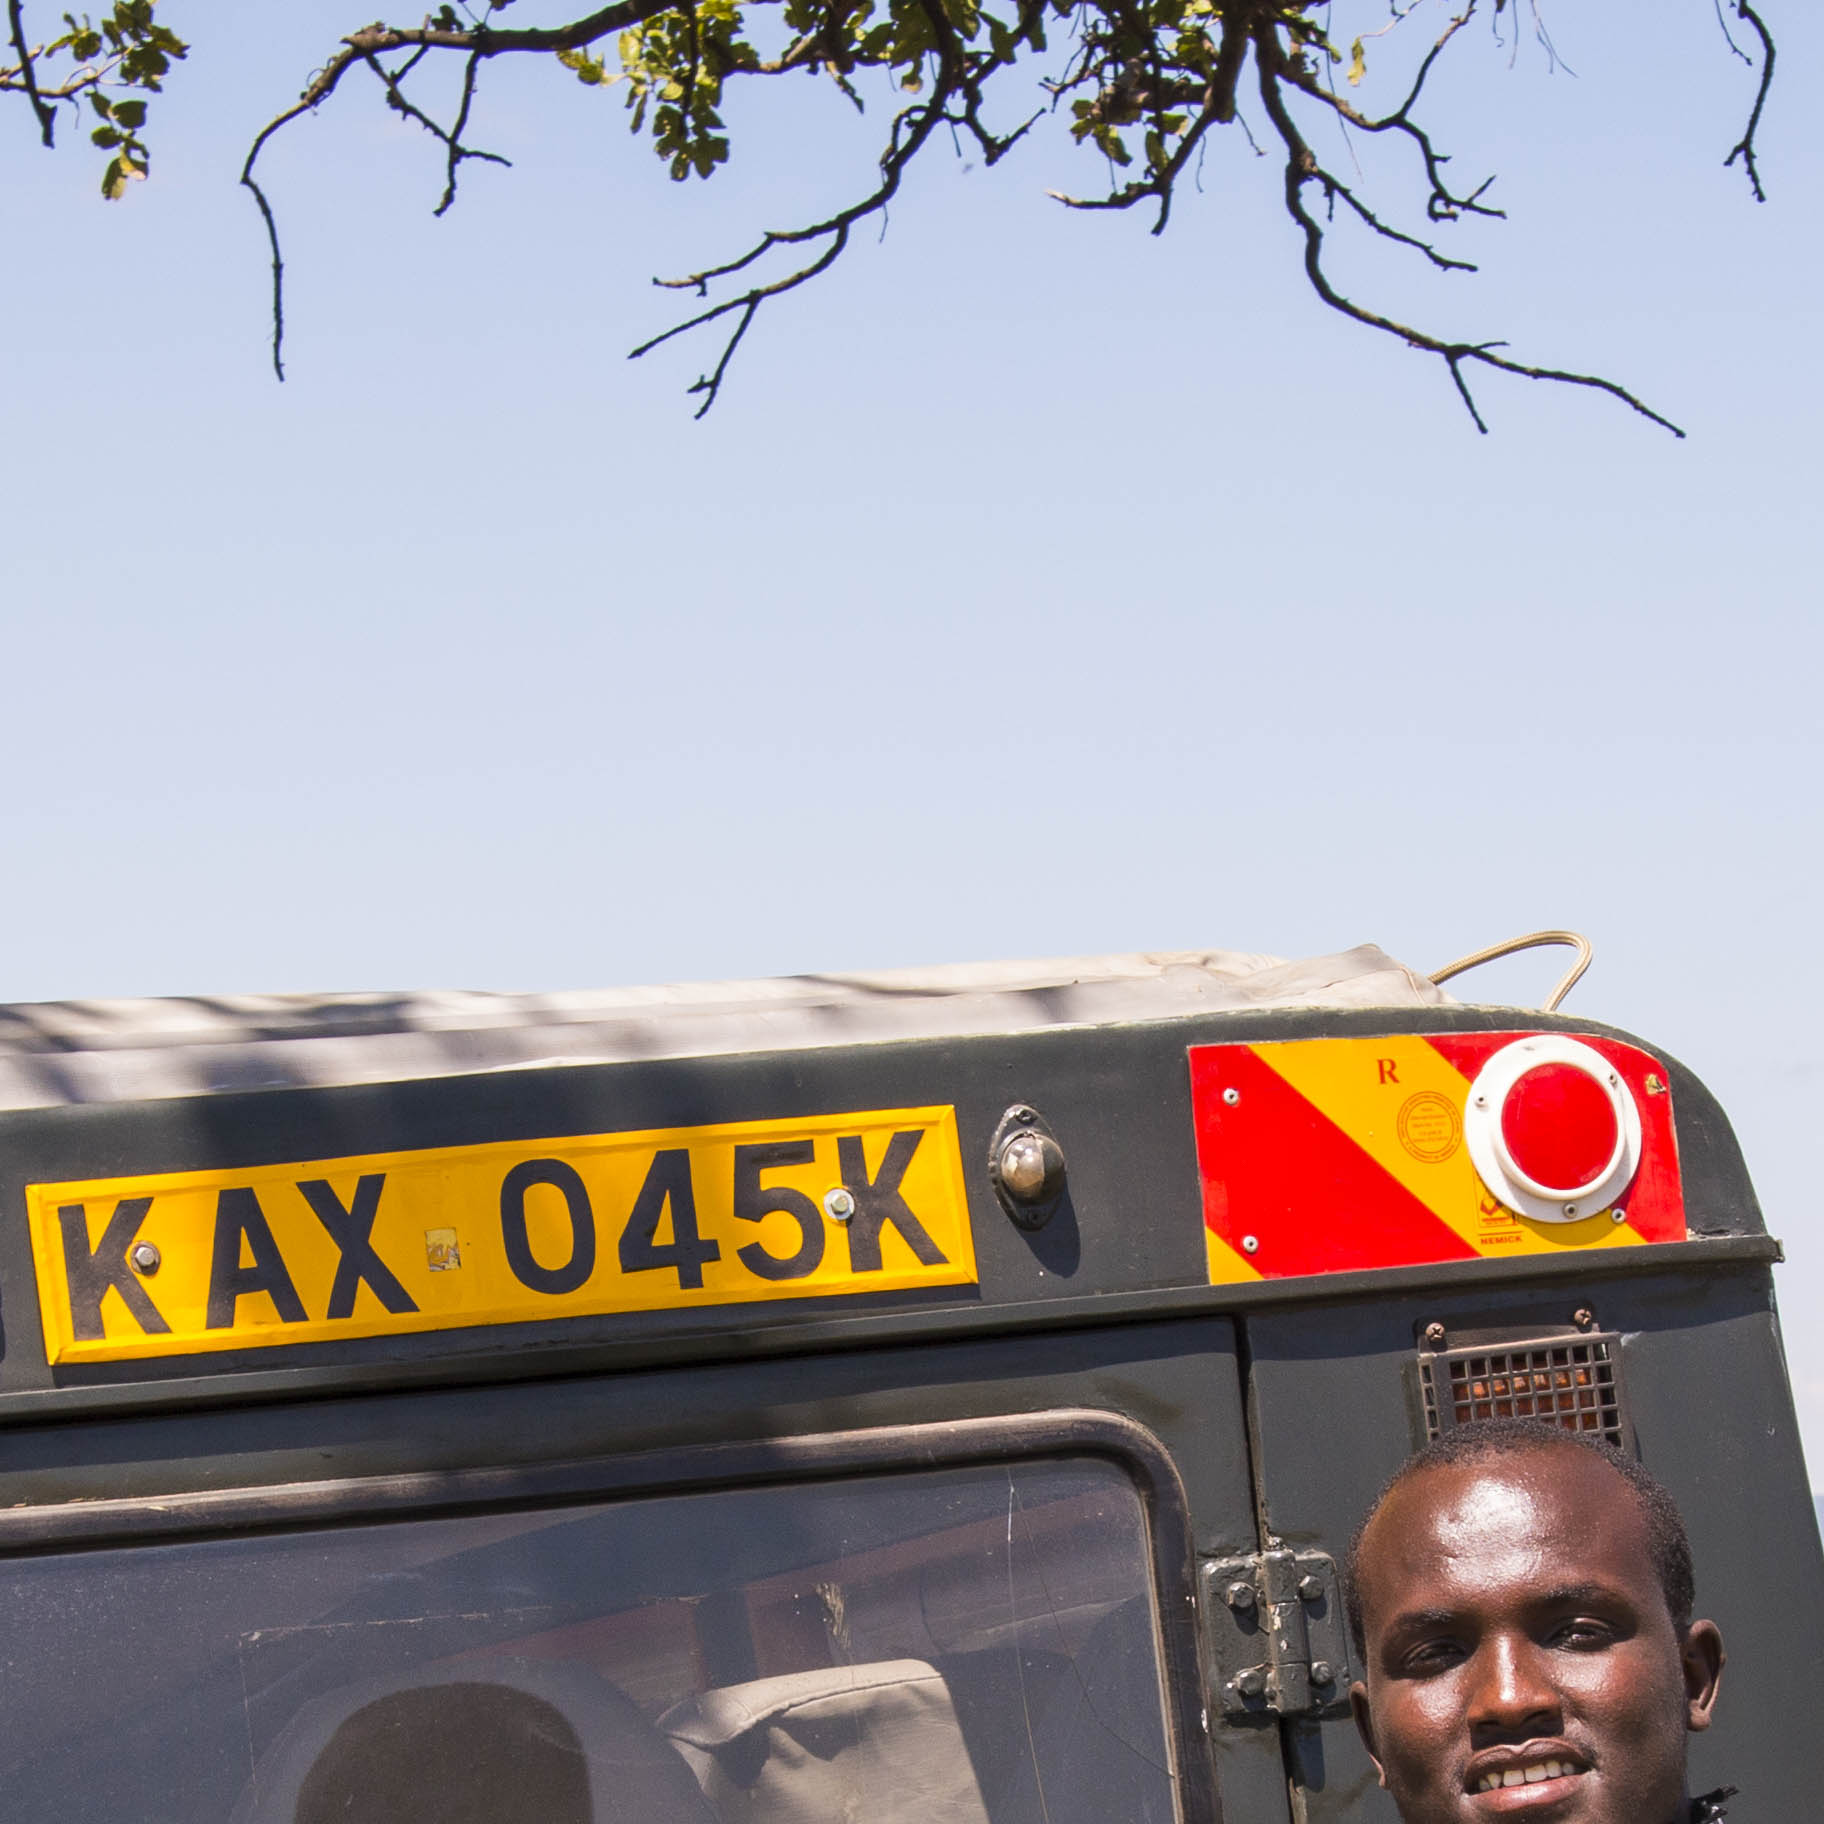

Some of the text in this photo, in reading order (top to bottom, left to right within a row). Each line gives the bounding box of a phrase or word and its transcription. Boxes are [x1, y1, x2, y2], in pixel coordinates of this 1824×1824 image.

[1376, 1058, 1400, 1086] R
[57, 1128, 951, 1342] KAX 045K
